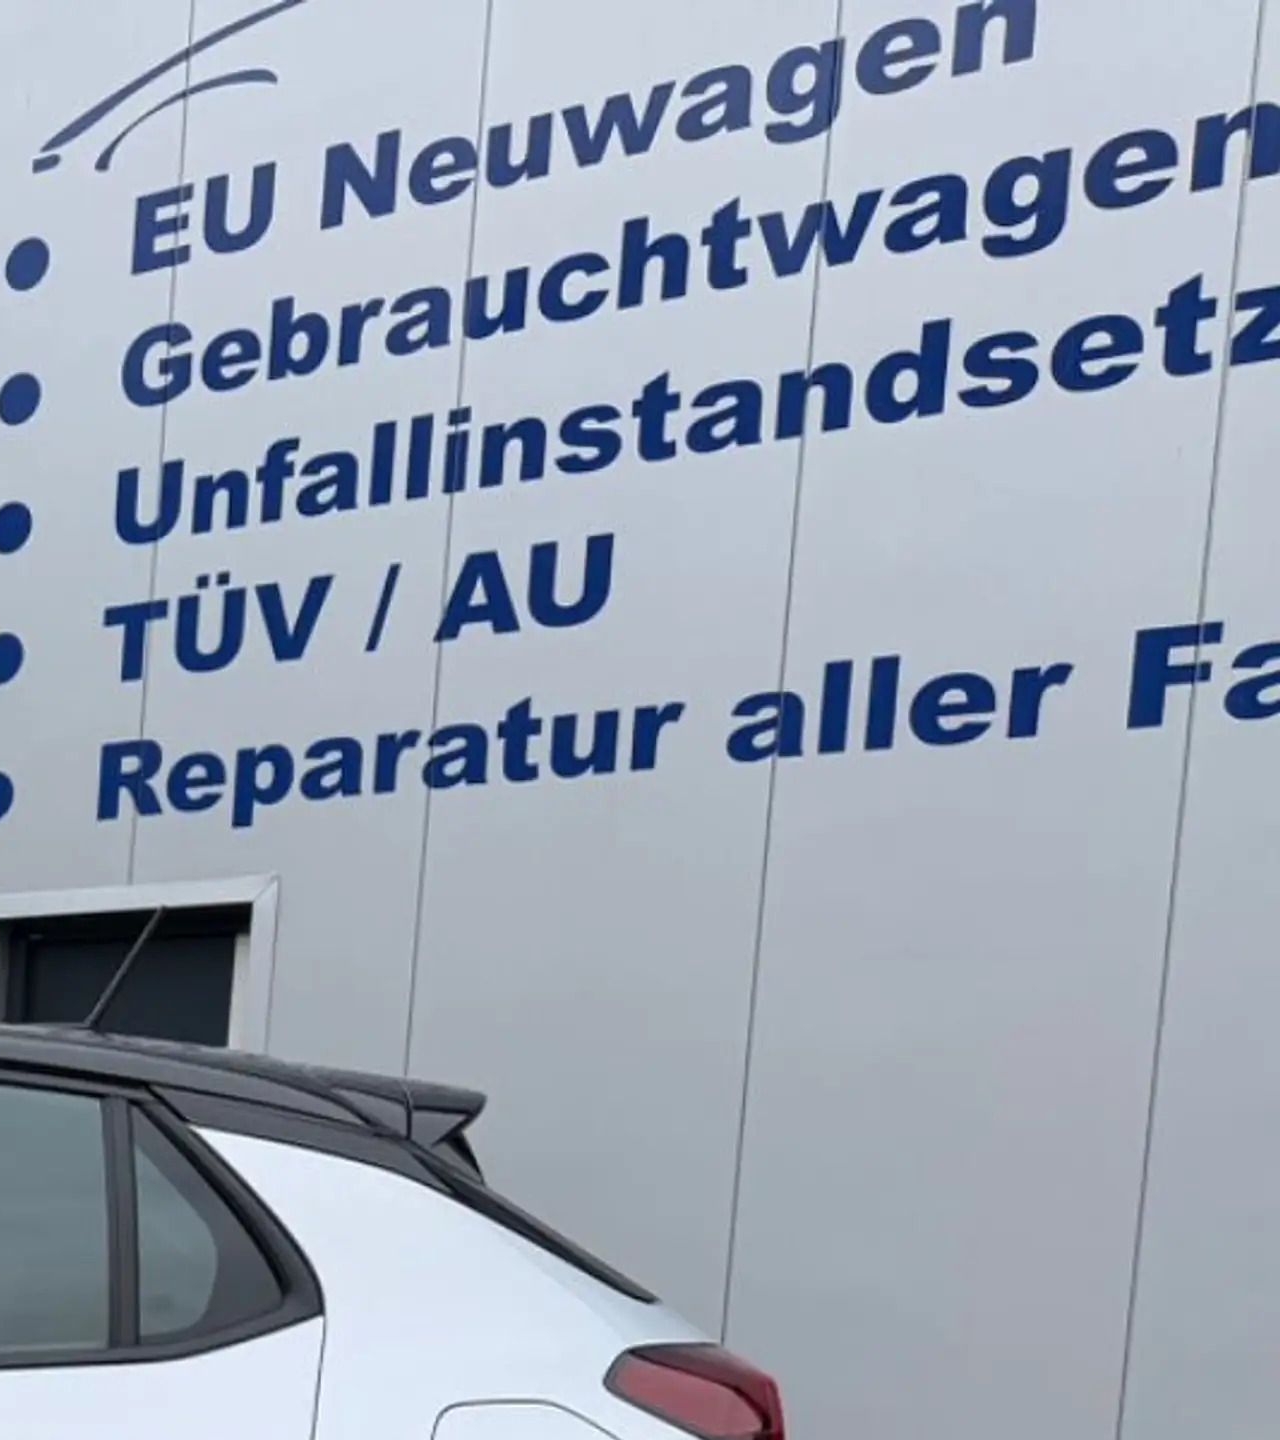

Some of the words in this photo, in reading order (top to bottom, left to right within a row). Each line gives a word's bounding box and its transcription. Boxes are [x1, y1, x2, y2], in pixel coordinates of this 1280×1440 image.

[121, 100, 1280, 408] Gebrauchtwagen
[131, 162, 276, 275] EU
[320, 0, 1037, 230] Neuwagen
[114, 273, 1280, 546] Unfallinstandsetz
[96, 696, 685, 829] Reparatur
[726, 654, 1074, 764] aller
[1127, 621, 1280, 730] Fa
[102, 571, 335, 683] TÜV
[365, 563, 401, 653] /
[433, 532, 614, 642] AU
